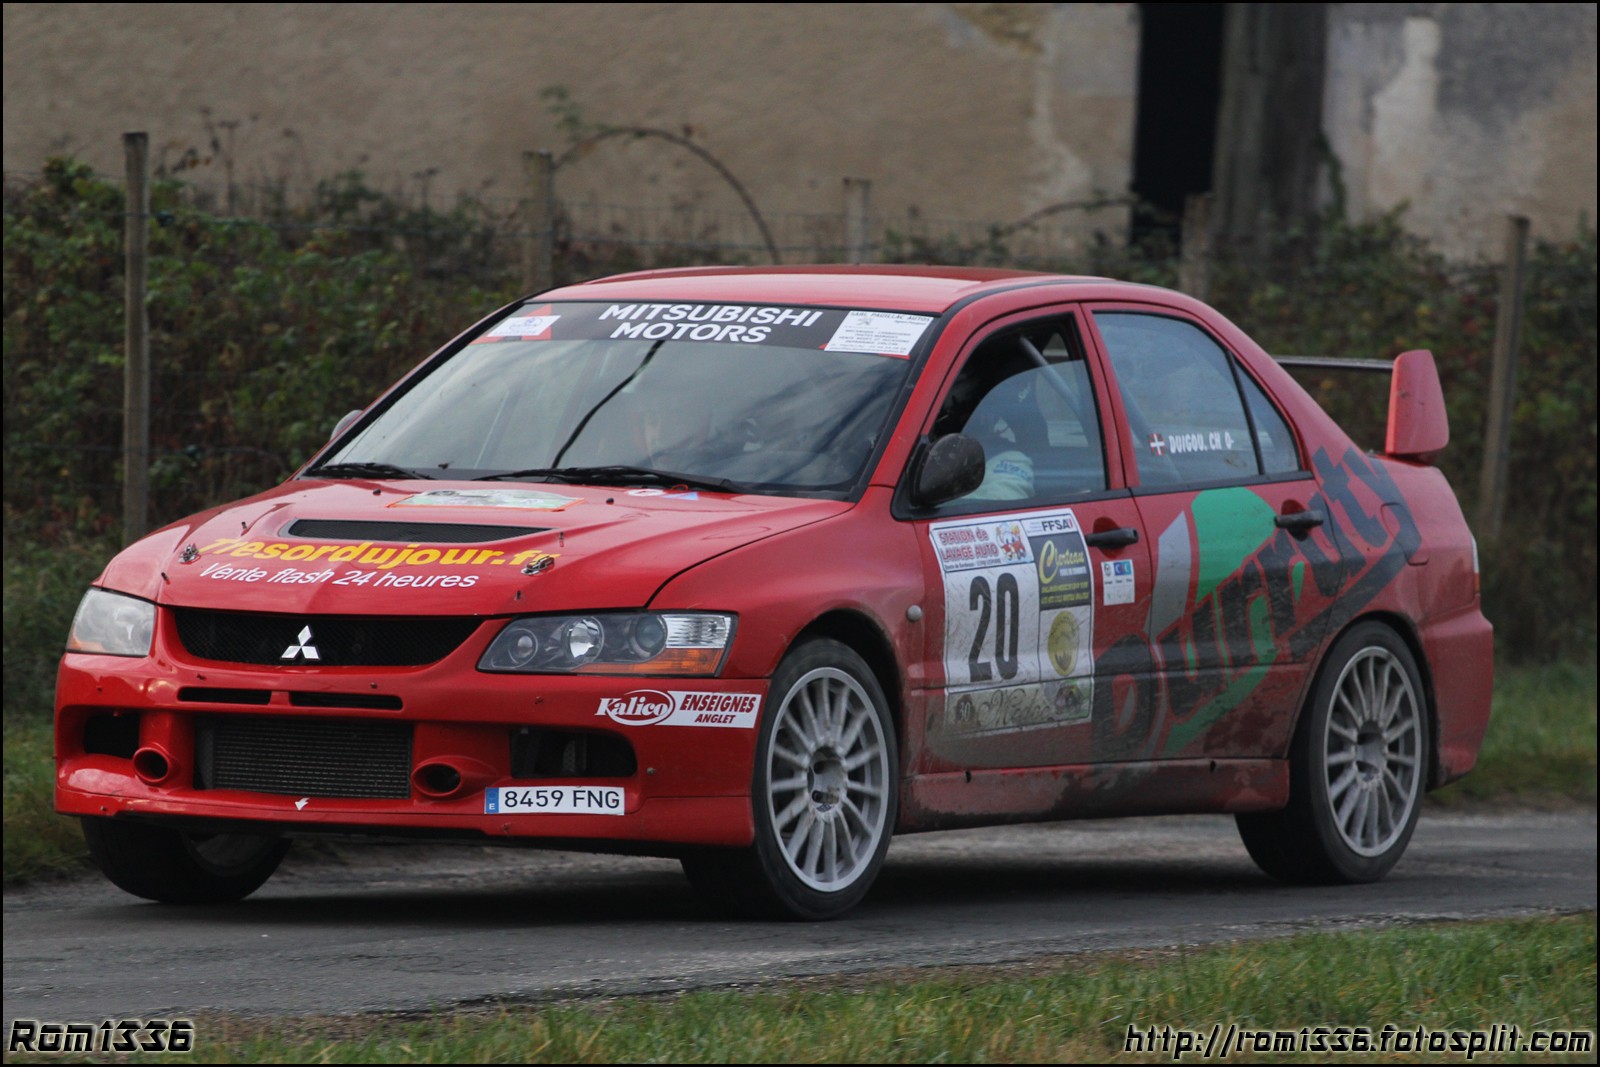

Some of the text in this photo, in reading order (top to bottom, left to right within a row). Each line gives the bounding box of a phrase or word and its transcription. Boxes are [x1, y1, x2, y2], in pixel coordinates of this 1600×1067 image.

[598, 304, 823, 327] MITSUBISHI
[609, 322, 772, 343] MOTORS
[1041, 518, 1070, 532] FFSA
[938, 526, 990, 546] STATION de
[940, 544, 976, 562] LAVAGE
[975, 541, 999, 559] AUTO
[199, 563, 480, 588] Vente flash 24 heures
[969, 572, 1020, 682] 20
[594, 696, 669, 716] Kalico
[679, 694, 757, 713] ENSEIGNES
[694, 713, 736, 724] ANGLET
[504, 790, 564, 808] 8459
[573, 790, 620, 809] FNG
